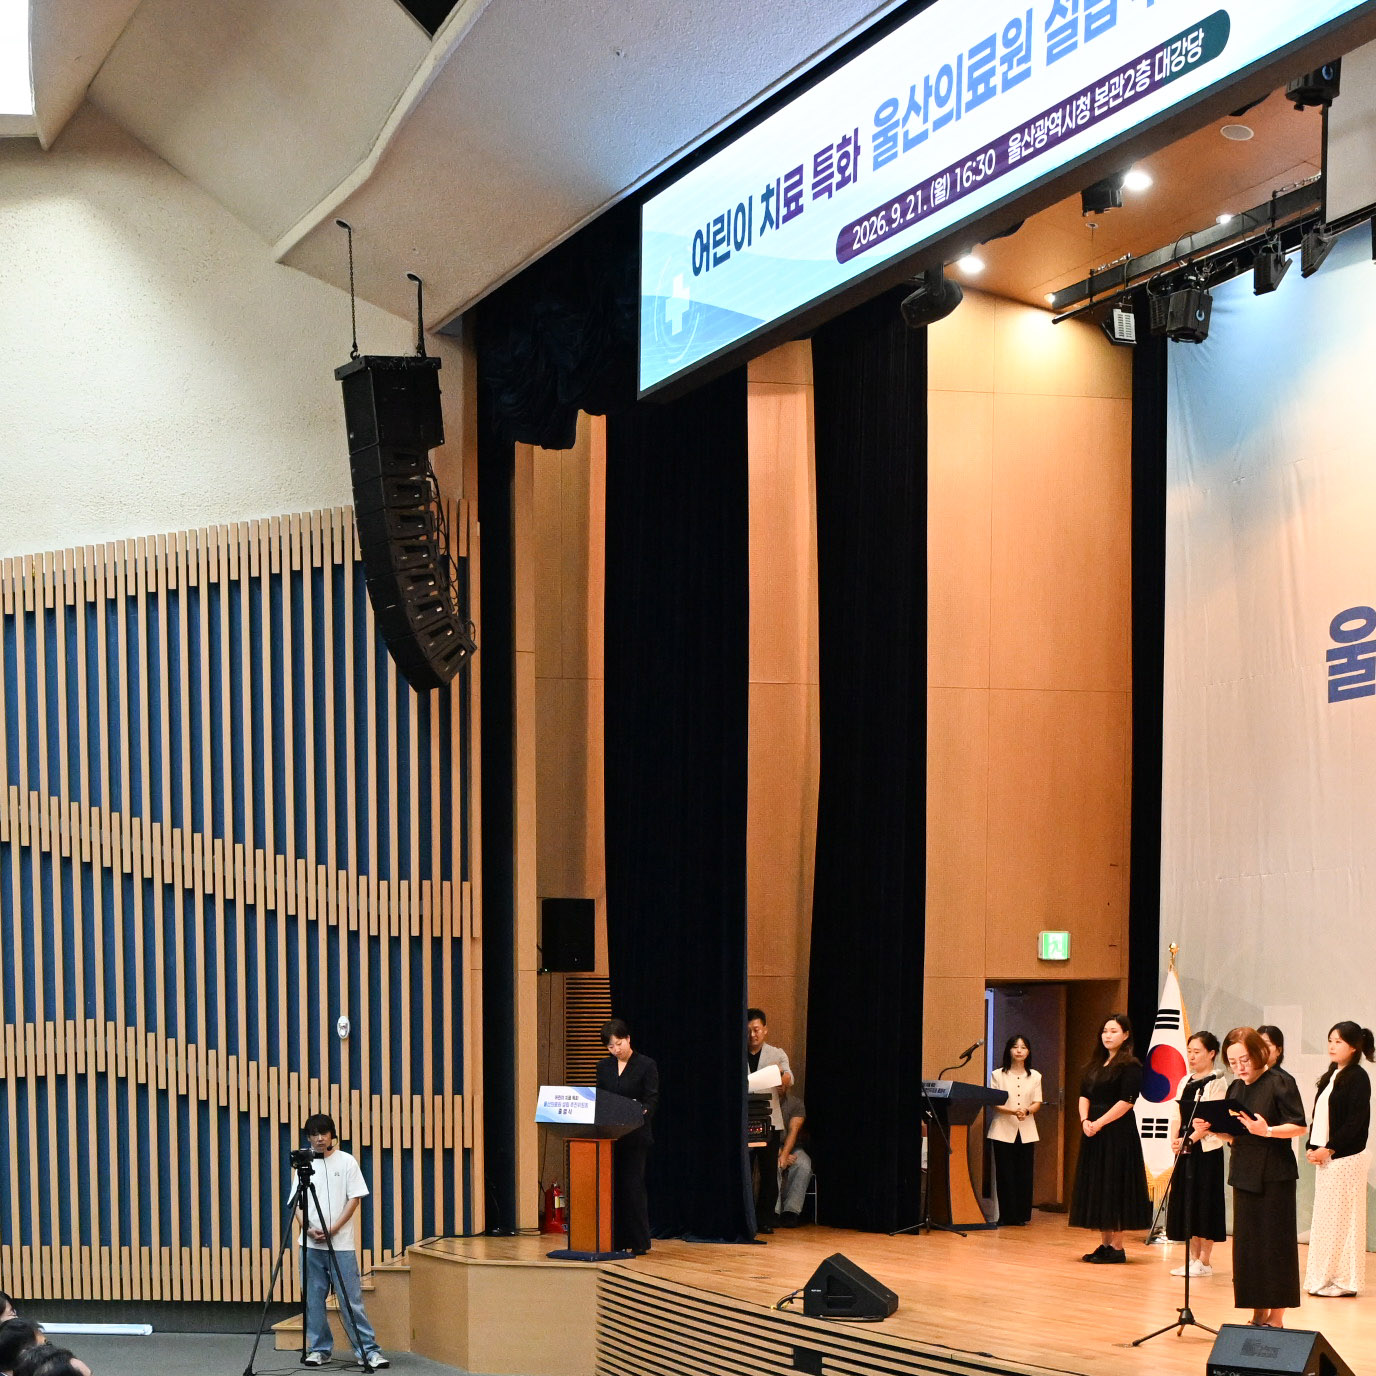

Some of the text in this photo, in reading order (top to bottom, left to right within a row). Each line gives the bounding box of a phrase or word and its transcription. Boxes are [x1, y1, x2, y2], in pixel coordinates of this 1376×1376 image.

[690, 217, 754, 278] 어린이
[758, 161, 805, 241] 치료
[811, 126, 862, 202] 특화
[871, 7, 1034, 172] 울산의료원
[852, 27, 1205, 252] 2026. 9. 21. (월) 16:30 울산광역시청 본관2층 대강당
